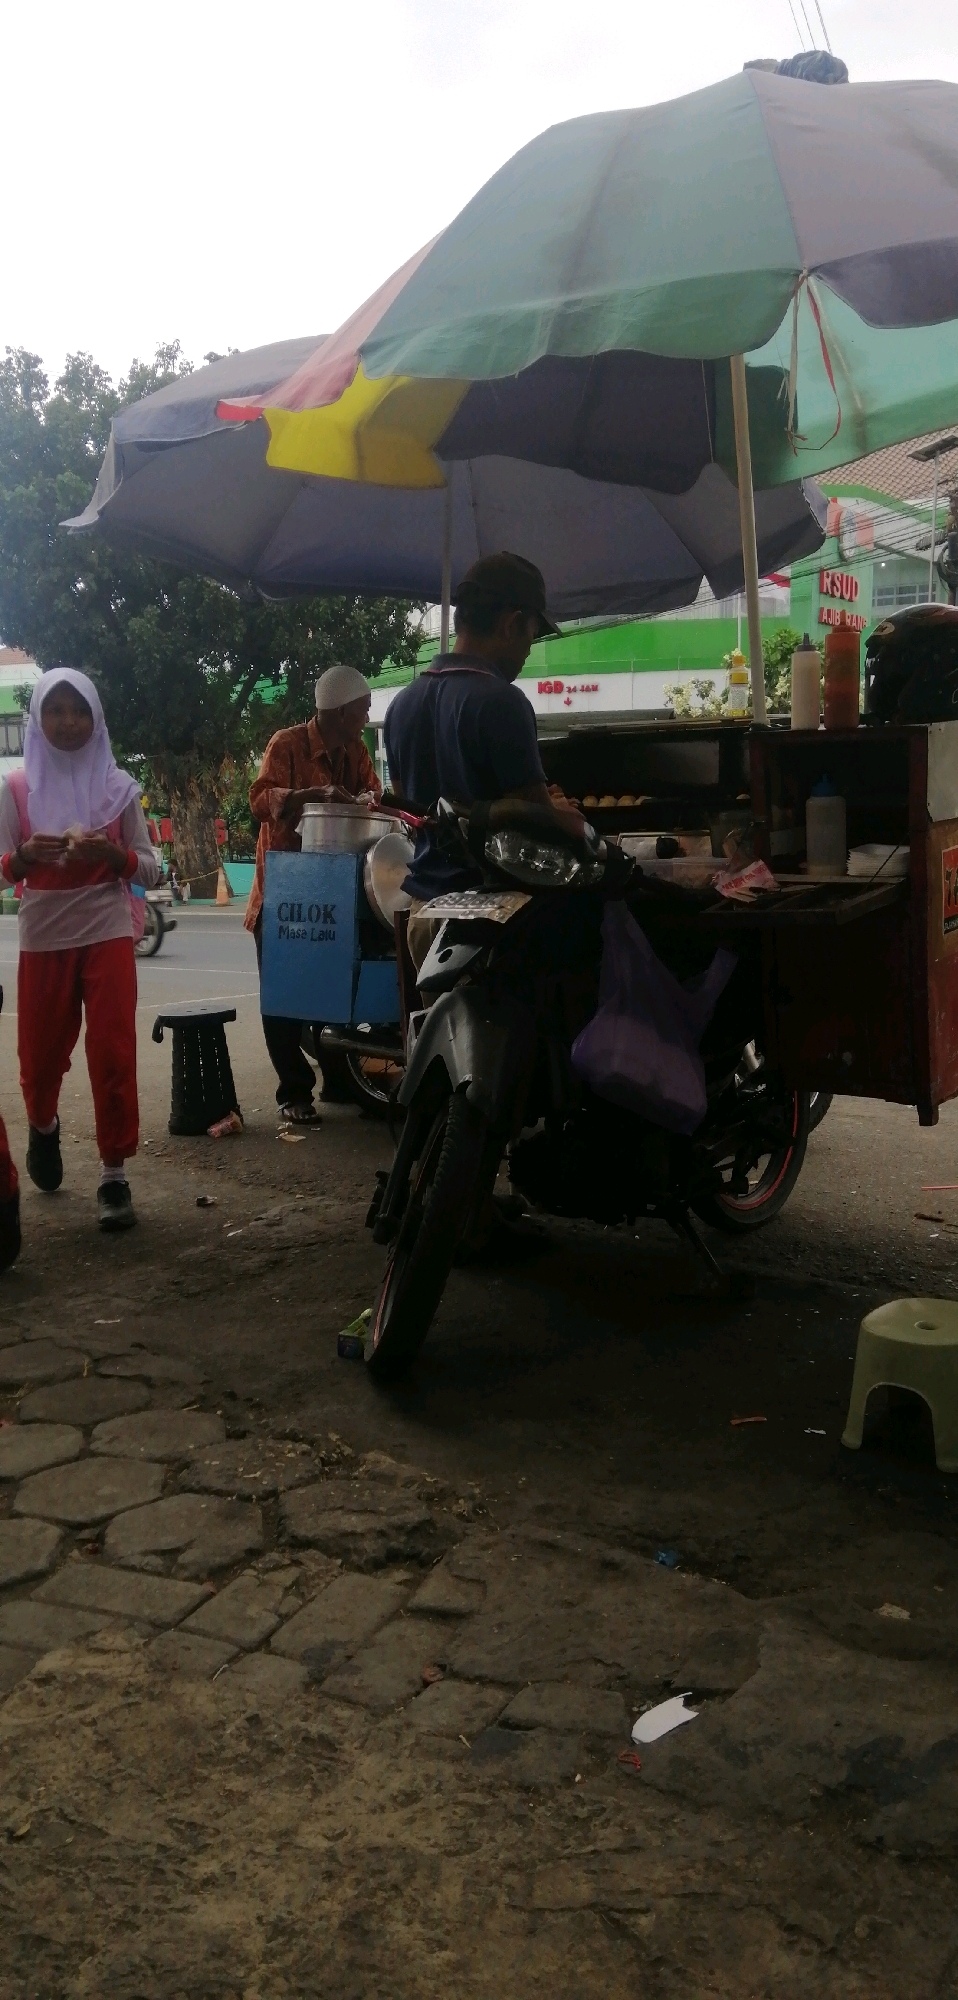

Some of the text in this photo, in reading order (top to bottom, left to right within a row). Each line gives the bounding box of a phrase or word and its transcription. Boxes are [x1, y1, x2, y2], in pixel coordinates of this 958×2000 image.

[820, 569, 860, 602] RSUD
[538, 681, 564, 694] IGD
[277, 902, 337, 925] CILOK
[310, 928, 336, 942] Lalu
